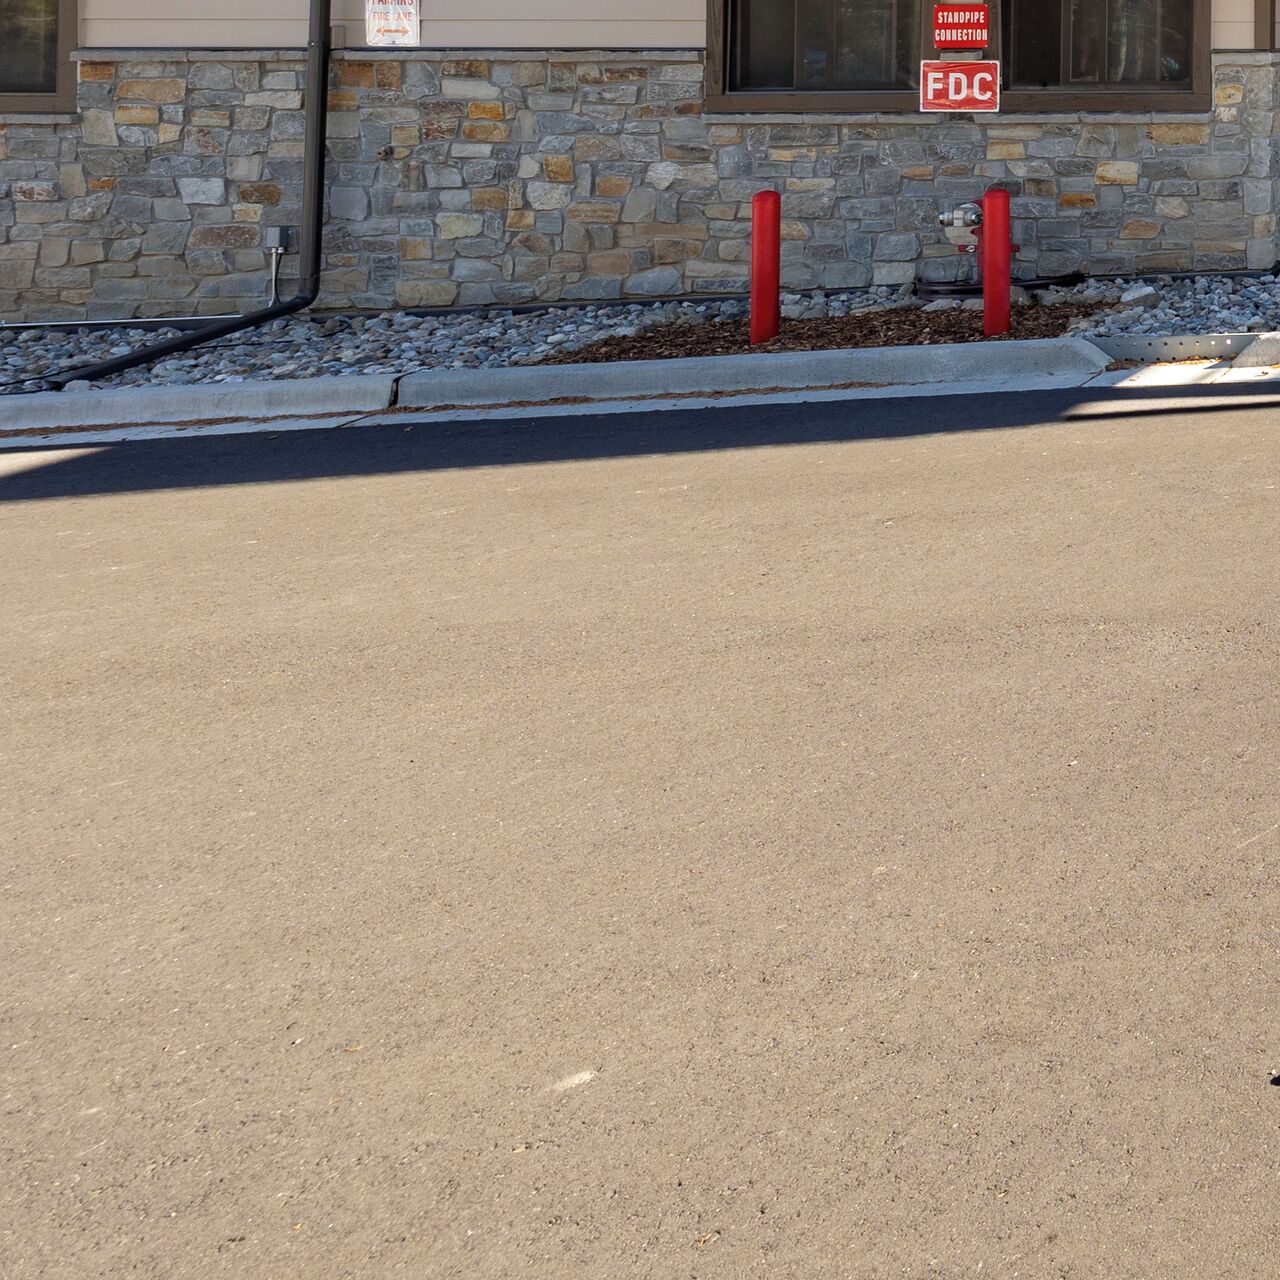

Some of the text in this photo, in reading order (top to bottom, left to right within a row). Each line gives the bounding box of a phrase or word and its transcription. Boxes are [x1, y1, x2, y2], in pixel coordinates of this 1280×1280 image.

[372, 11, 390, 22] FIRE
[937, 11, 985, 23] STANDPIPE
[934, 28, 988, 41] CONNECTION
[926, 72, 993, 101] FDC
